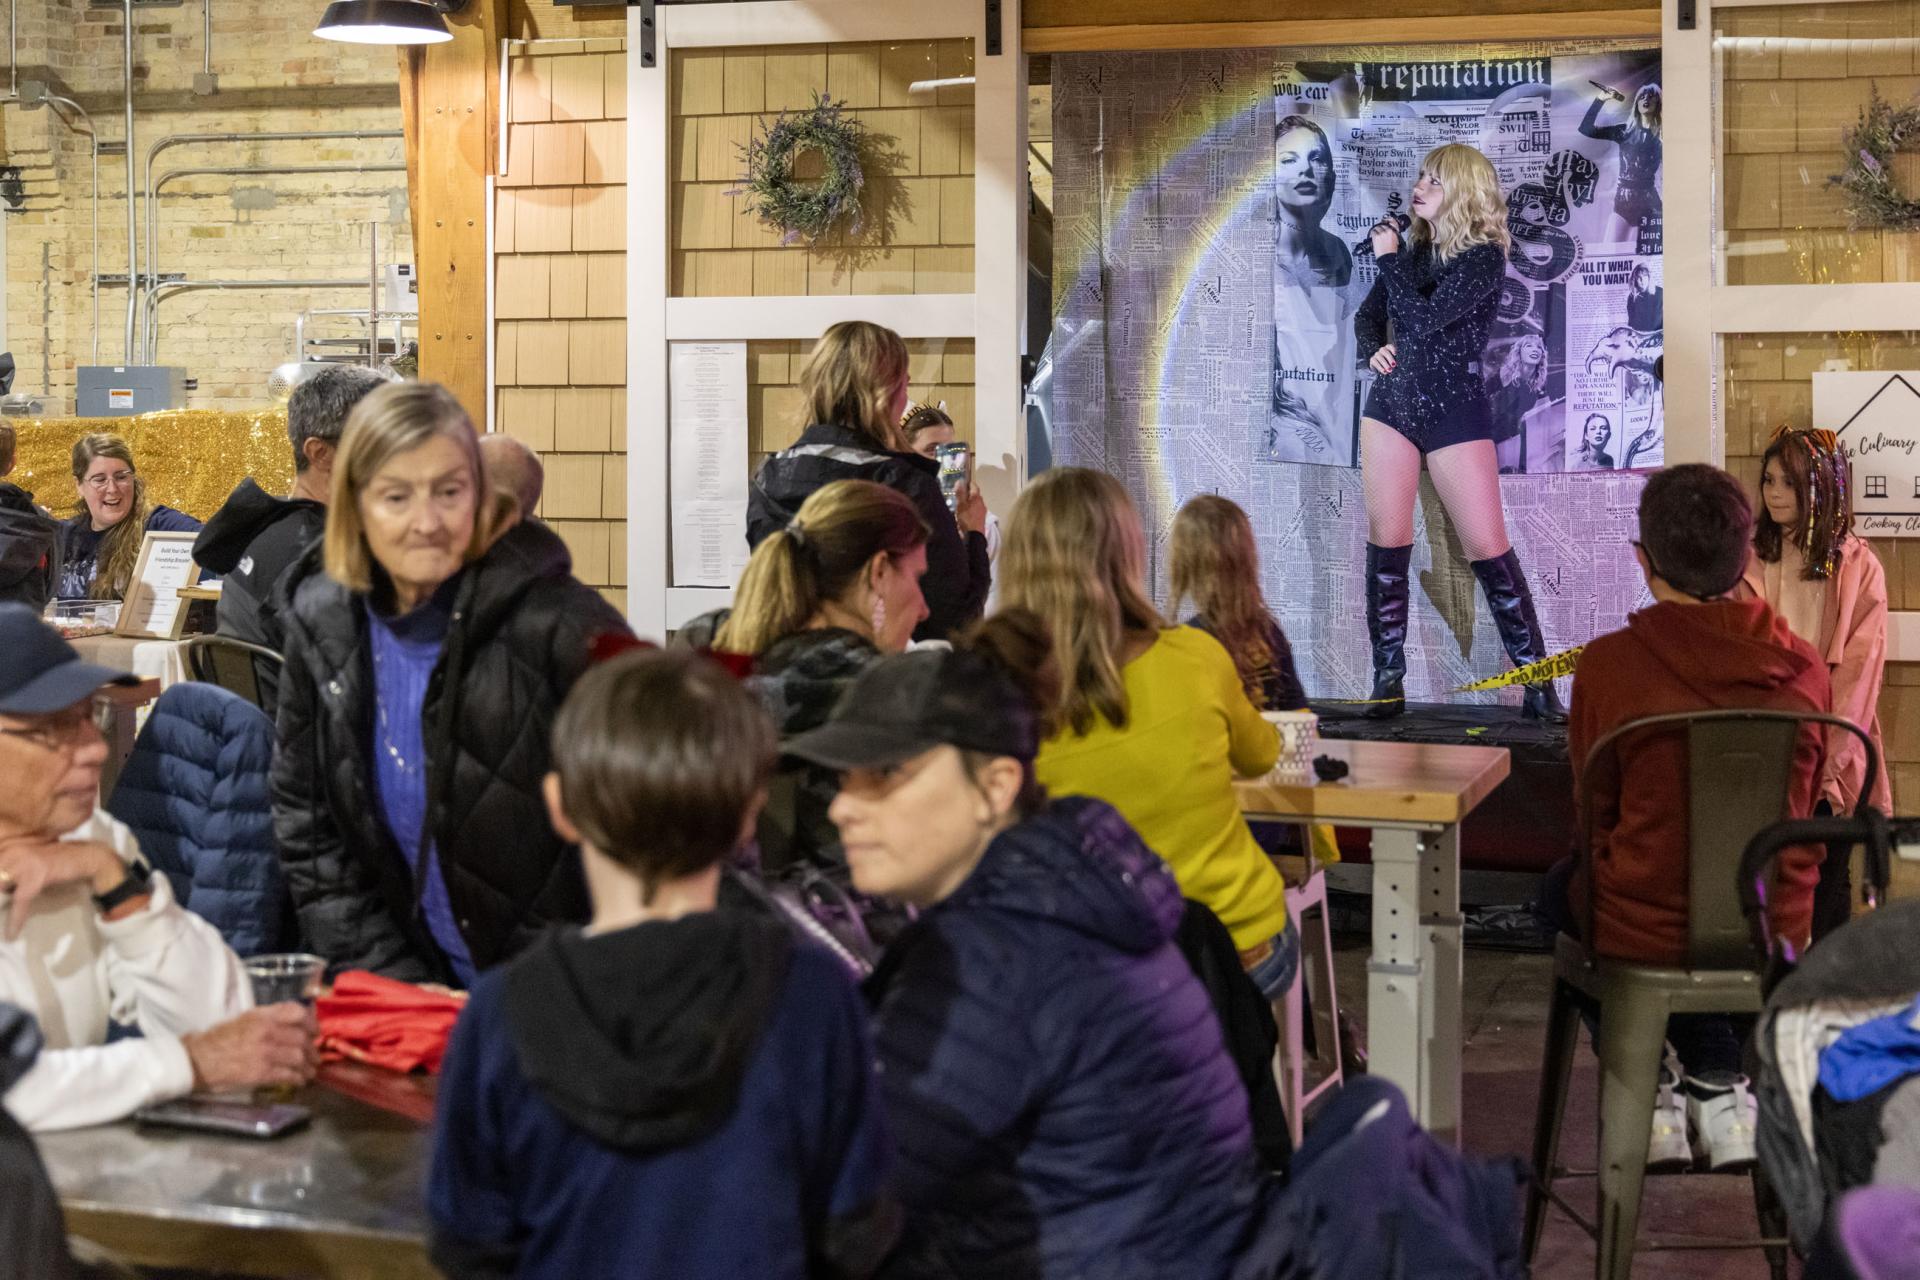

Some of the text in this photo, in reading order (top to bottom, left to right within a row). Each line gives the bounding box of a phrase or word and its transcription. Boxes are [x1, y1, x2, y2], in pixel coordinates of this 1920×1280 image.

[1381, 59, 1545, 97] reputation
[1305, 87, 1329, 100] car
[1361, 147, 1417, 160] Taylor Swift,
[1359, 158, 1386, 168] taylor
[1359, 167, 1386, 177] taylor
[1336, 213, 1378, 231] Taylor
[1640, 230, 1660, 240] love
[1597, 262, 1607, 272] IT
[1609, 260, 1633, 272] WHAT
[1583, 273, 1630, 285] YOU WANT
[1860, 432, 1918, 456] Culinary
[1863, 516, 1902, 533] Cooking
[1510, 671, 1529, 685] DO
[1531, 661, 1554, 678] NOT
